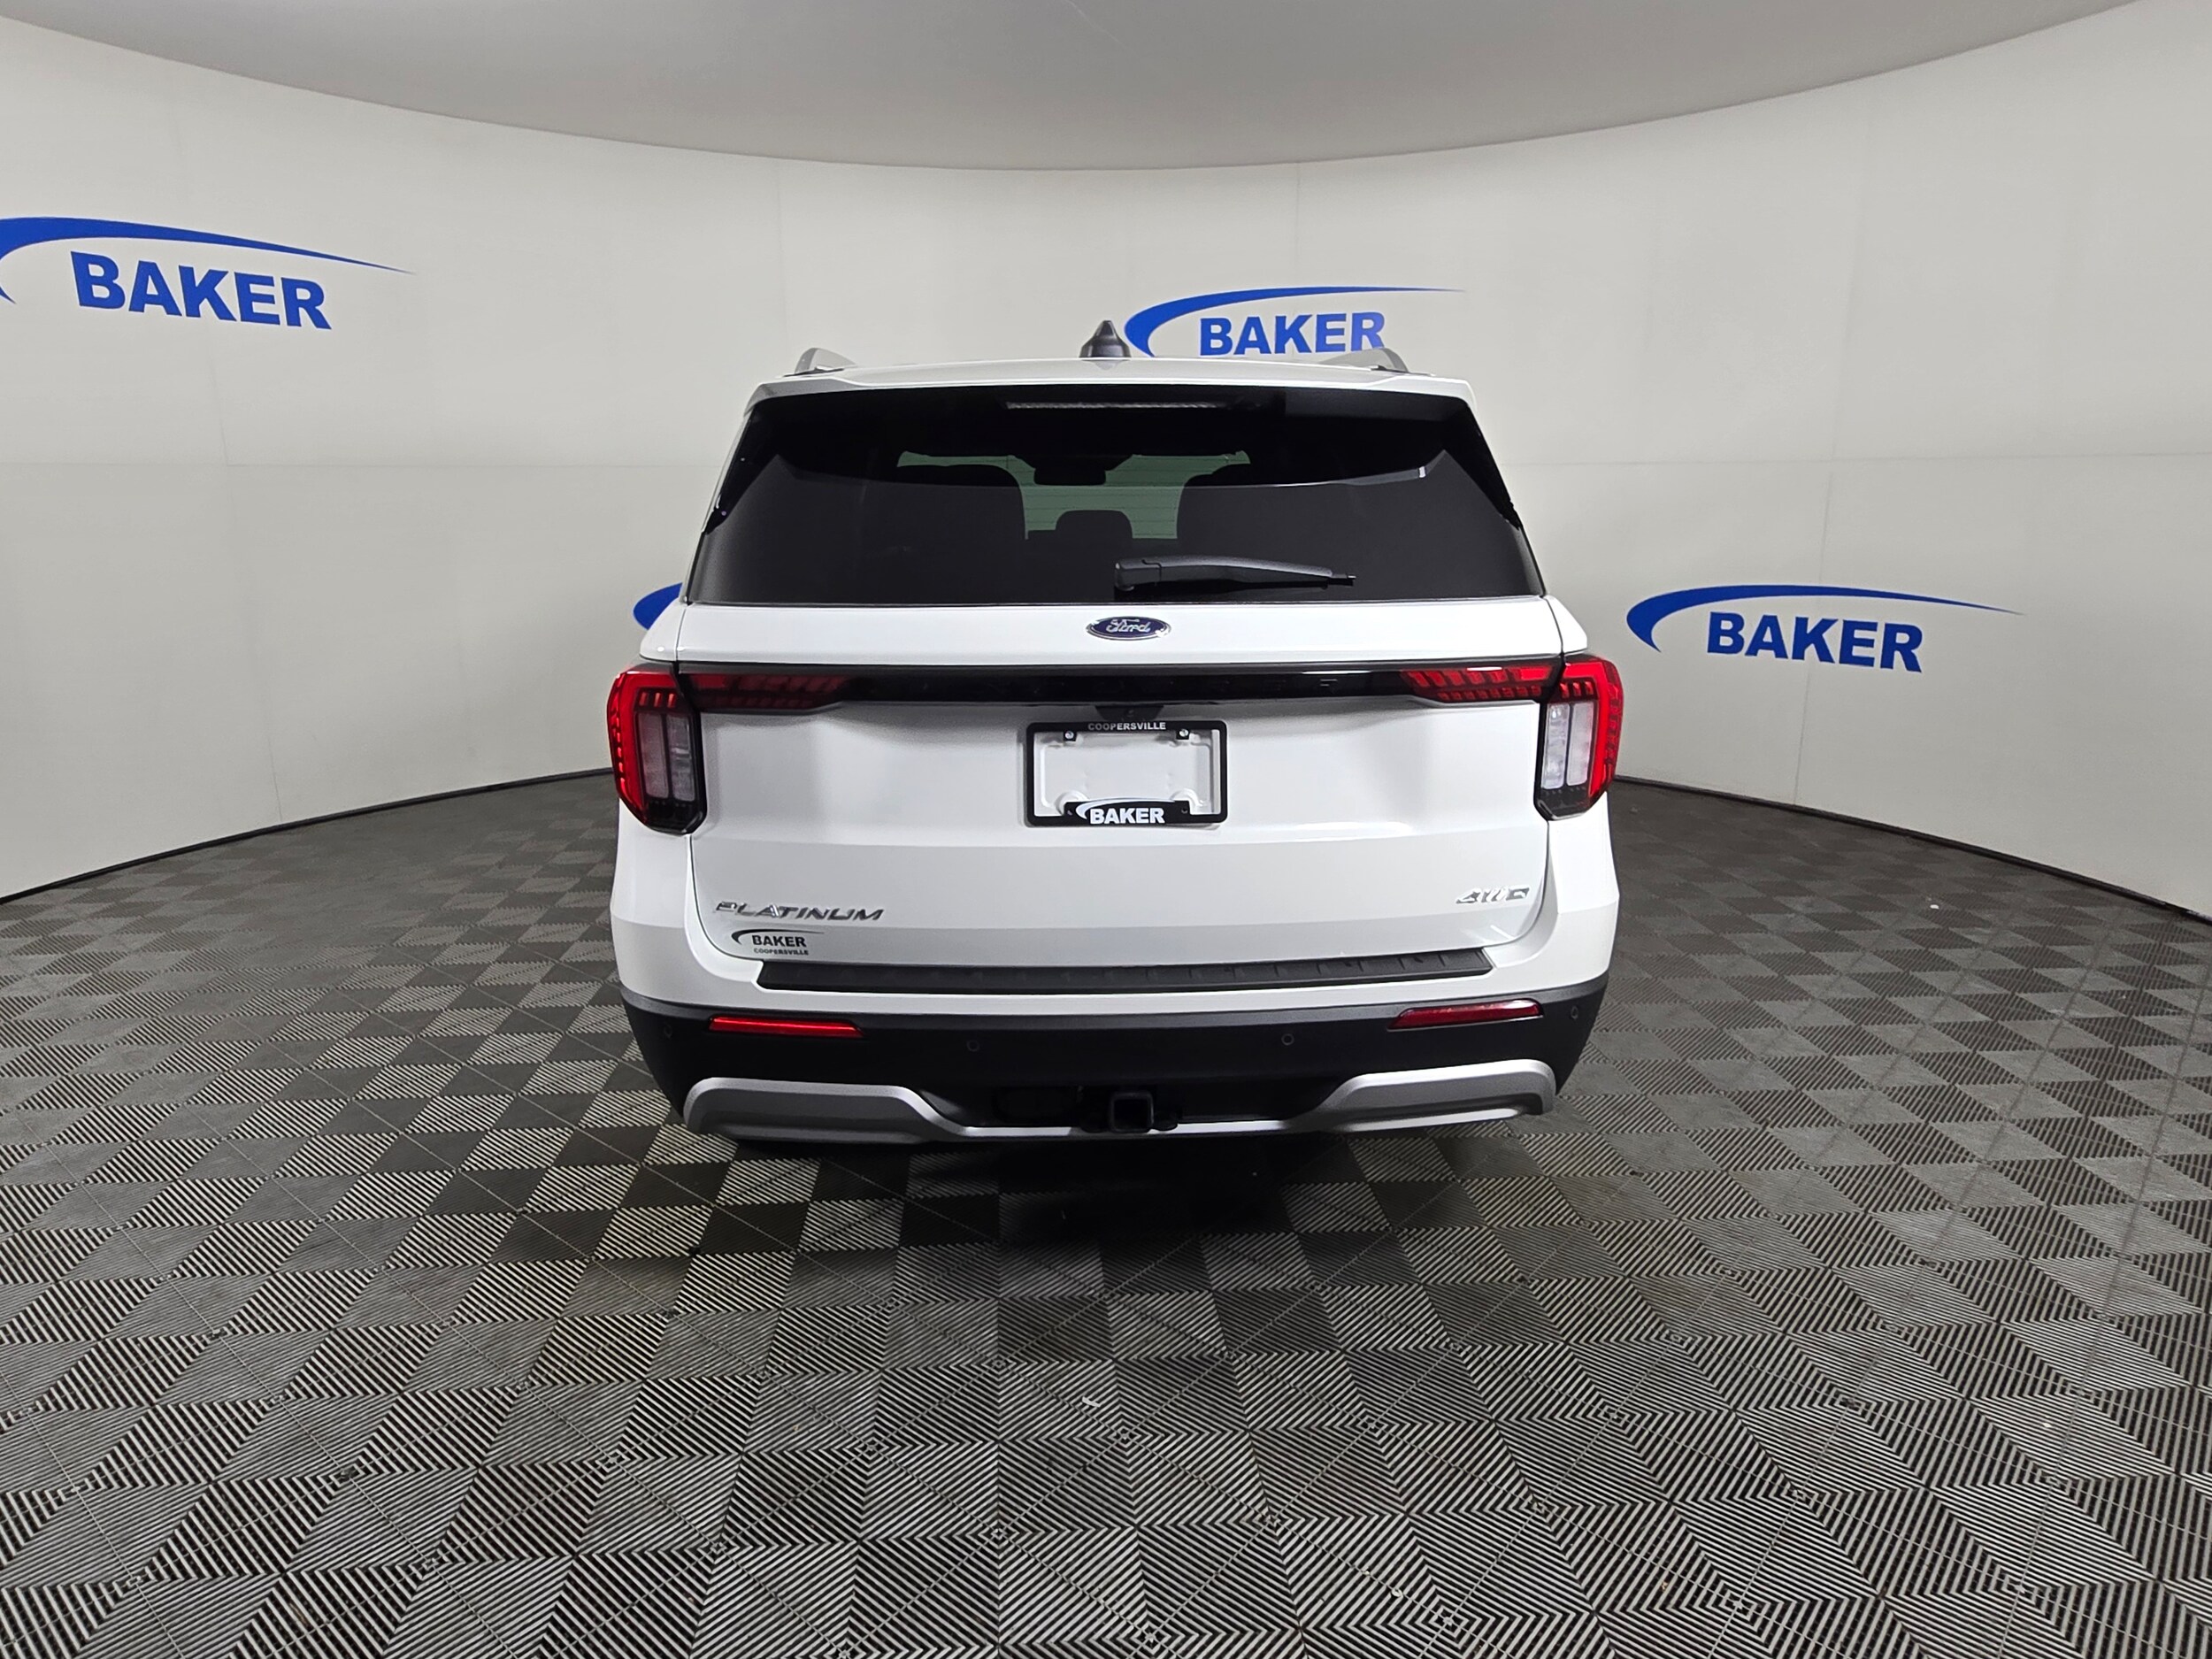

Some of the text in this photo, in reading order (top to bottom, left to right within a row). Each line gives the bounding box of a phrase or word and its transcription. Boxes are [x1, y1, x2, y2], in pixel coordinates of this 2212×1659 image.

[70, 250, 332, 330] BAKER
[1200, 311, 1386, 356] BAKER
[1105, 618, 1152, 634] Ford
[1707, 611, 1924, 673] BAKER
[1087, 721, 1167, 731] COOPERSVILLE
[1089, 807, 1165, 825] BAKER
[715, 901, 885, 921] PLATINUM
[751, 934, 808, 948] BAKER
[753, 947, 810, 956] COOPERSVILLE
